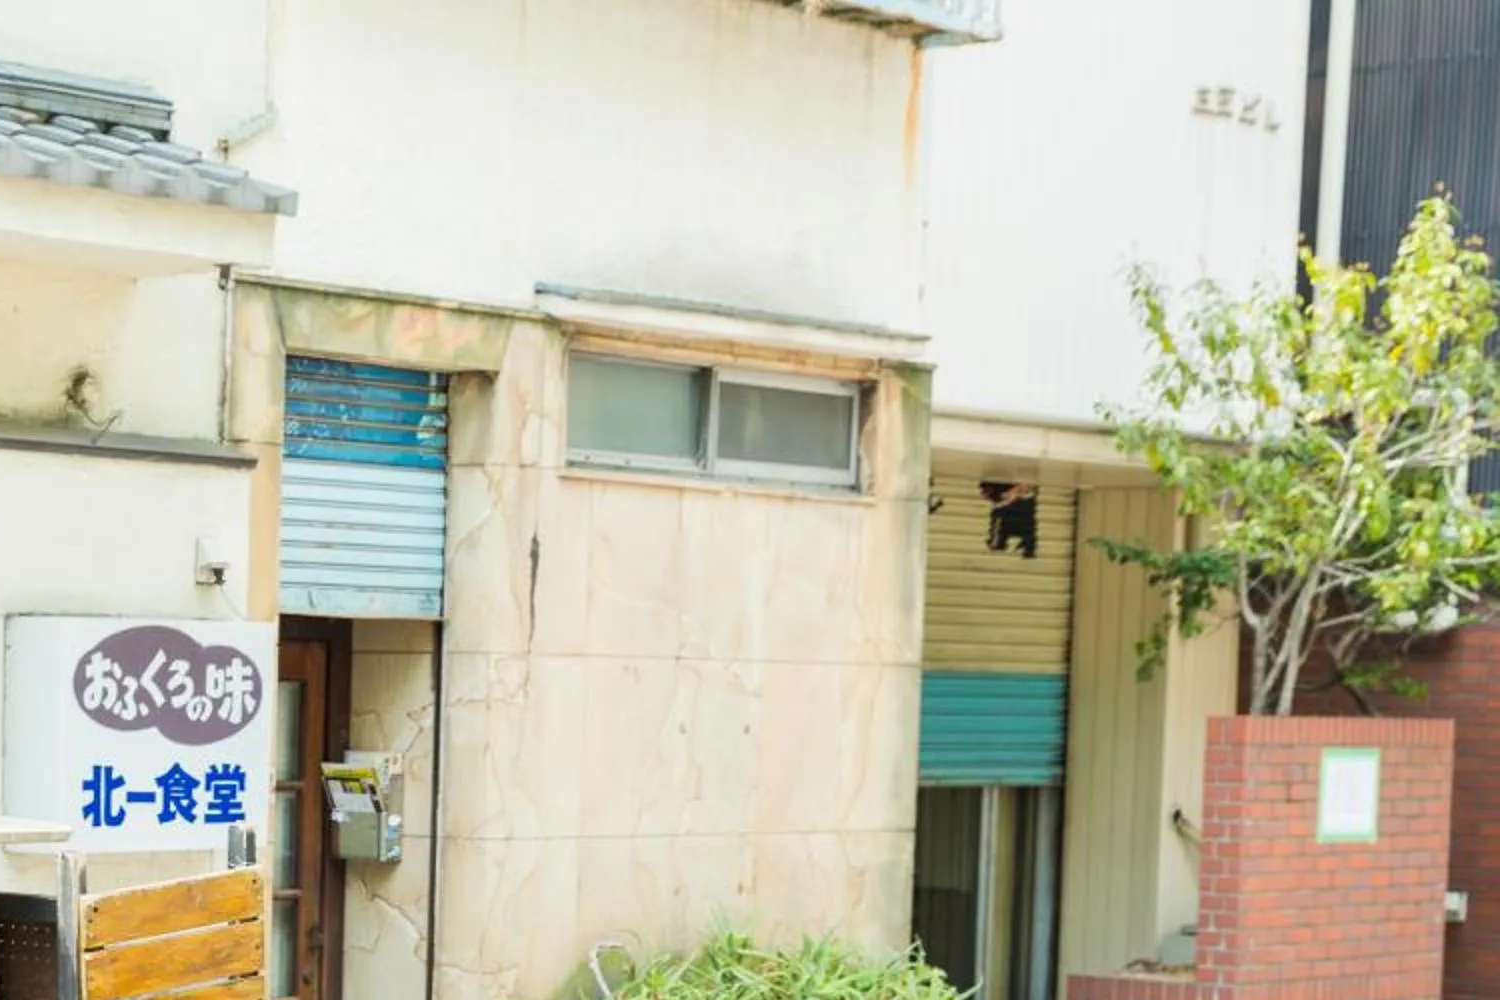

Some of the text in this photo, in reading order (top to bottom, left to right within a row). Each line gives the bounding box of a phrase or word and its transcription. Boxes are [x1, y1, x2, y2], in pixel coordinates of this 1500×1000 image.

[83, 648, 257, 725] おふくろの味
[82, 762, 246, 827] 北一食堂
